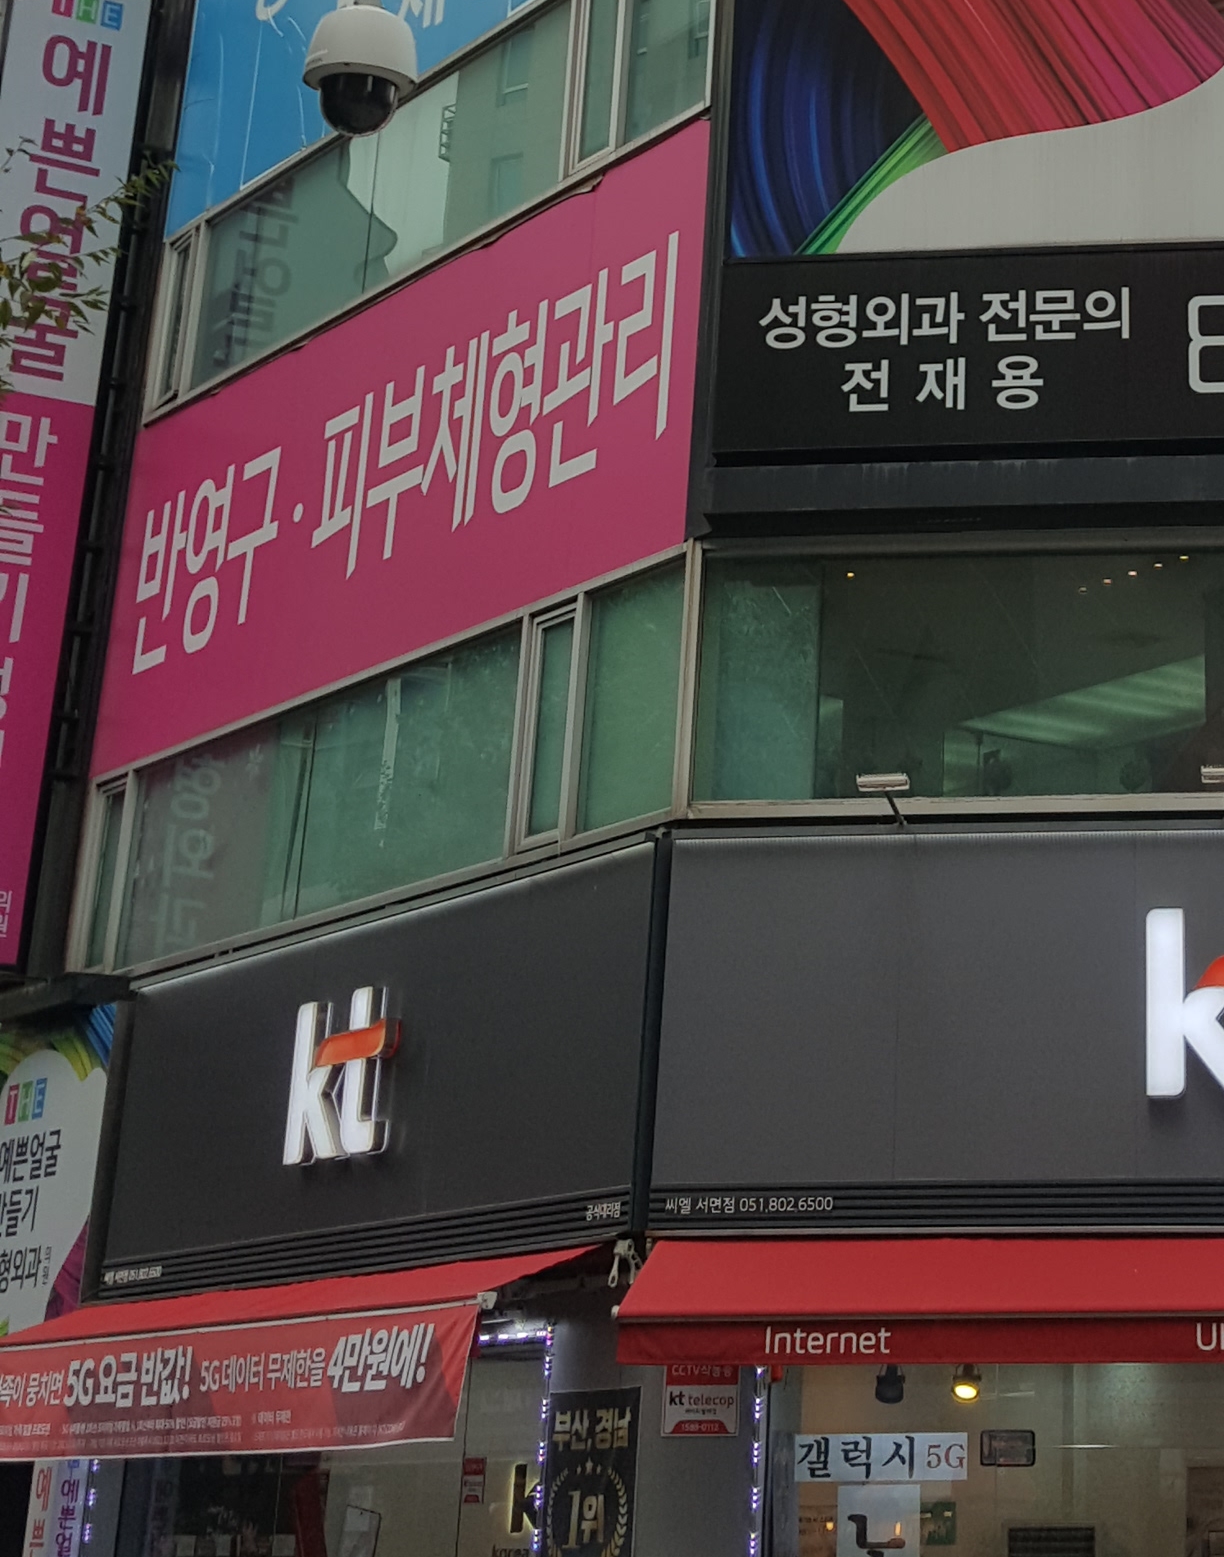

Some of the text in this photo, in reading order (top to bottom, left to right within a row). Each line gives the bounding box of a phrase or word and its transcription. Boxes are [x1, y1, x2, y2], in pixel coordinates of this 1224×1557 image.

[758, 285, 1132, 349] 성형외과 전문의
[282, 985, 401, 1166] kt
[0, 1185, 40, 1239] 들기
[664, 1196, 834, 1215] 씨엘 서면점 051.802.6500
[200, 1322, 436, 1393] 5G 데이터 무제한을 4만원에!
[764, 1324, 892, 1355] Internet
[0, 1373, 27, 1409] 족이
[63, 1358, 96, 1407] 5G
[95, 1351, 138, 1408] 요금
[140, 1345, 194, 1407] 반값!
[669, 1391, 686, 1406] kt
[926, 1443, 966, 1470] 5G
